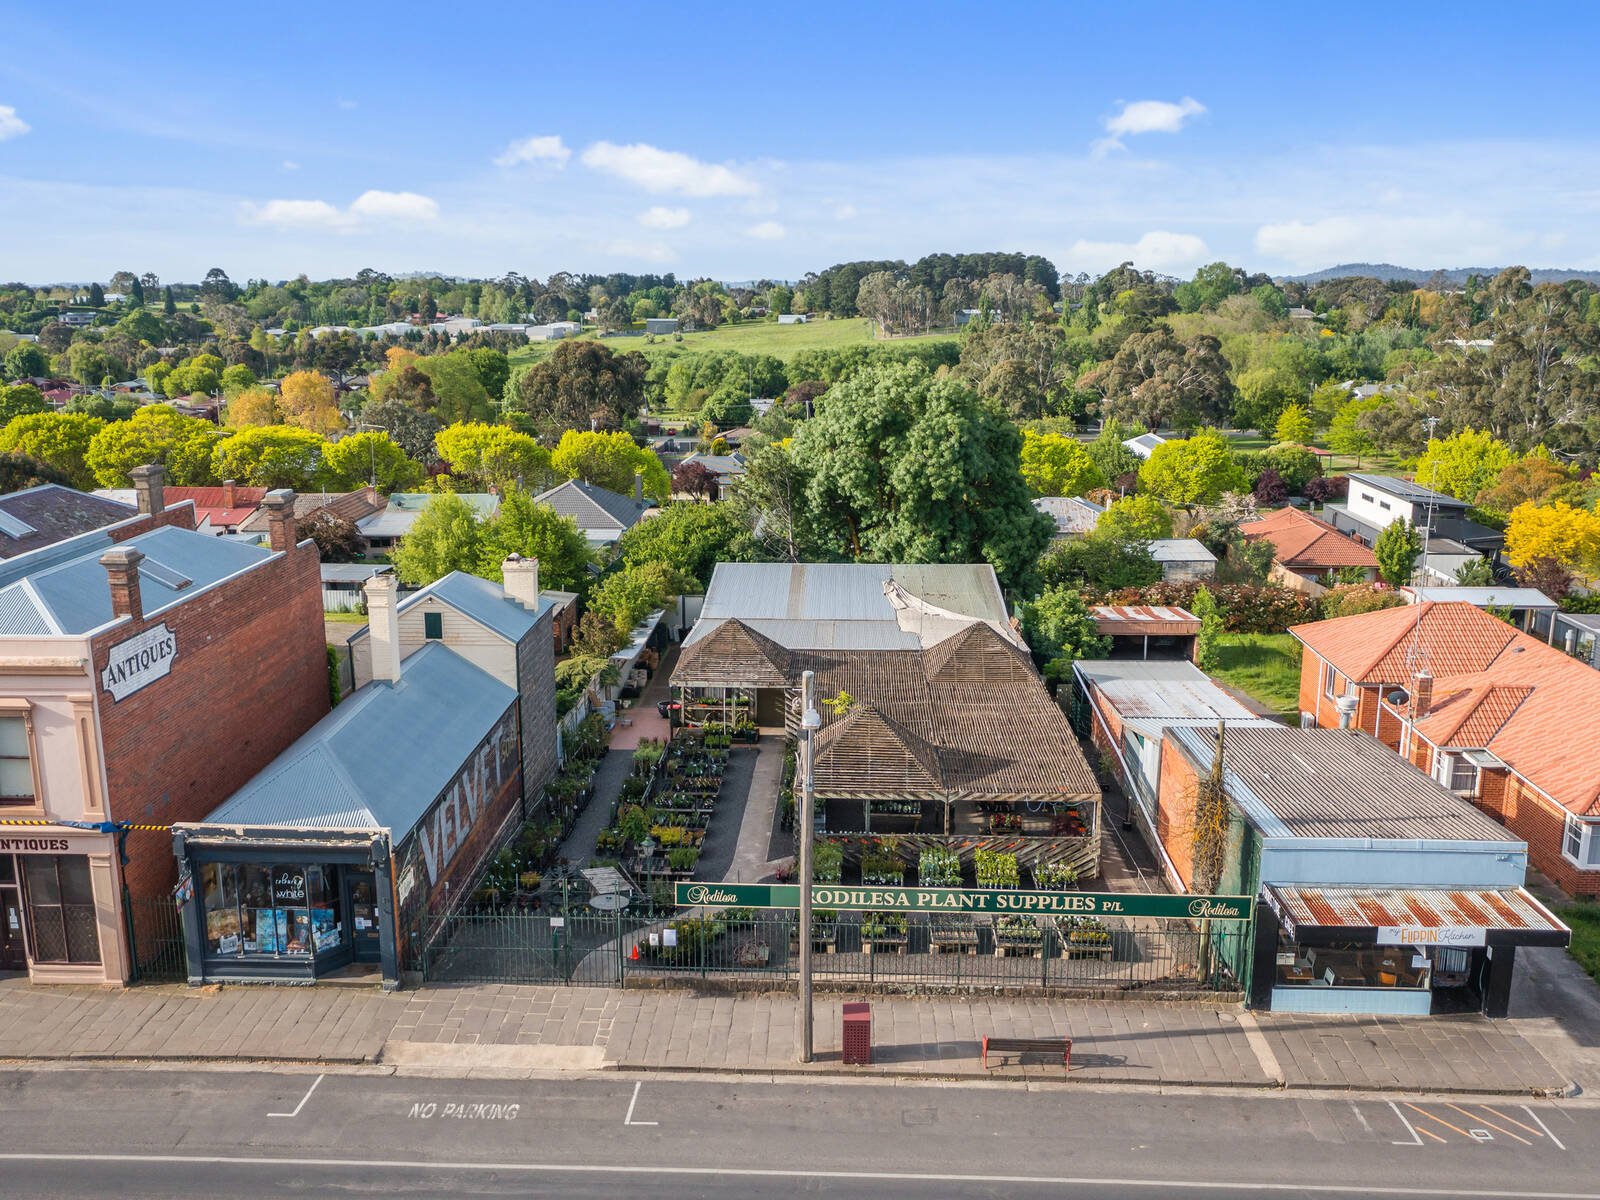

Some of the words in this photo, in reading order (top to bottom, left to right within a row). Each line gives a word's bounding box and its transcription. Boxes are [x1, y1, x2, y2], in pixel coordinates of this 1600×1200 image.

[107, 637, 173, 688] ANTIQUES
[419, 724, 504, 887] VELVET
[687, 885, 738, 904] Rodilesa
[917, 893, 989, 909] PLANT
[997, 895, 1096, 911] SUPPLIES
[1102, 902, 1124, 912] P/L
[1188, 899, 1239, 917] Rodilesa
[408, 1103, 437, 1118] NO
[441, 1103, 520, 1119] PARKING
